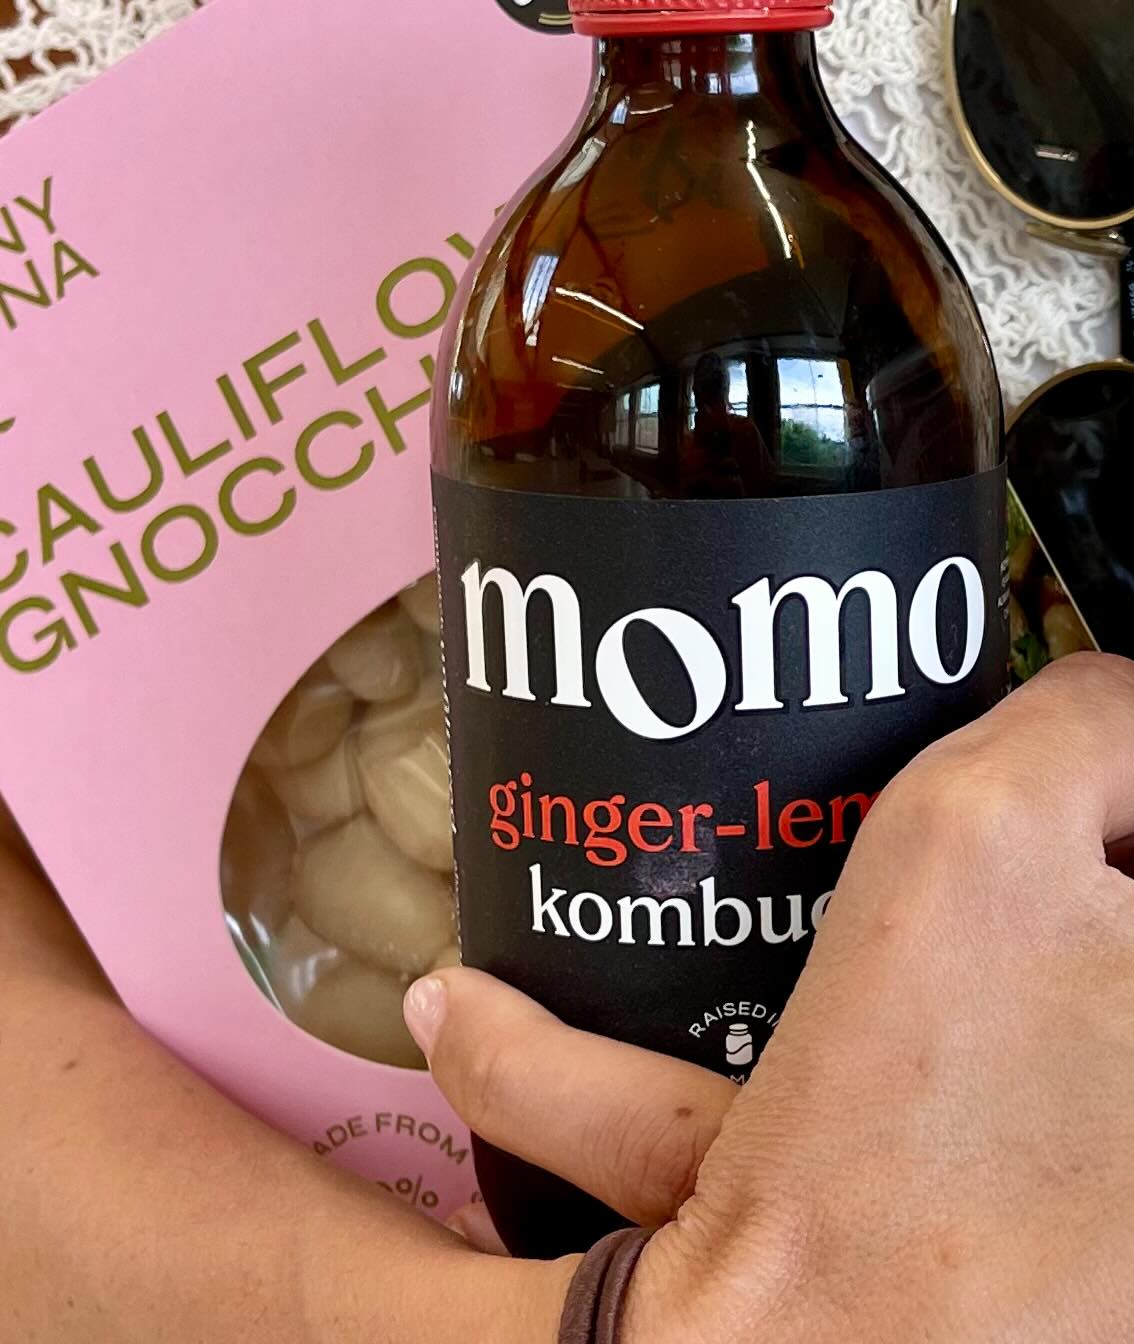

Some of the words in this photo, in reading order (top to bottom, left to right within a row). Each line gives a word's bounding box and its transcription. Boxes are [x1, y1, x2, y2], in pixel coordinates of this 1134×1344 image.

[0, 232, 475, 593] AULIFLO
[461, 557, 986, 741] momo
[688, 1001, 767, 1038] RAISED
[767, 1012, 780, 1027] I
[375, 1112, 469, 1165] FROM
